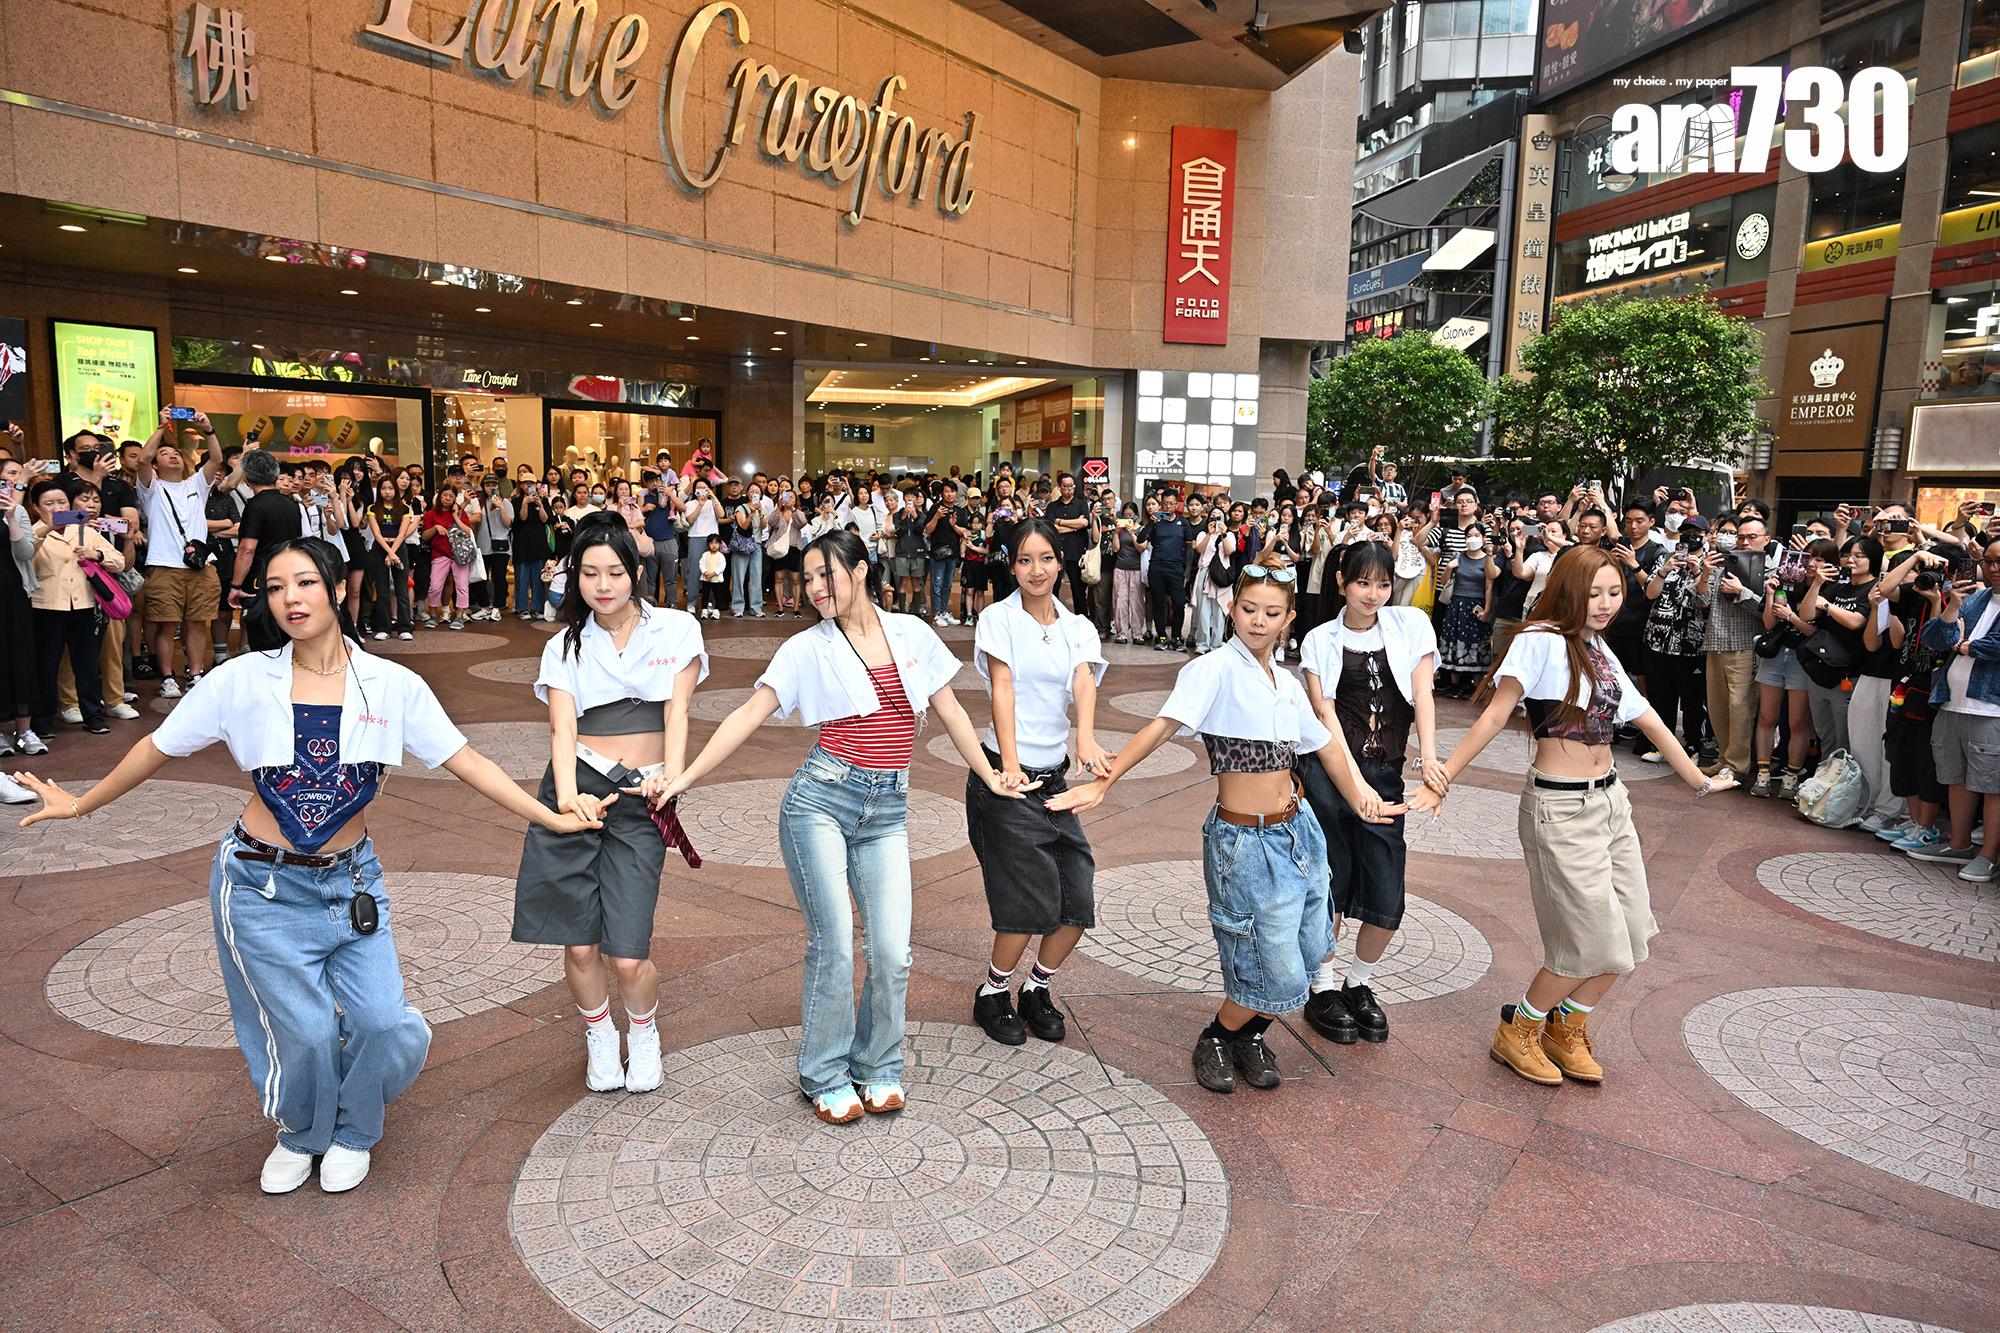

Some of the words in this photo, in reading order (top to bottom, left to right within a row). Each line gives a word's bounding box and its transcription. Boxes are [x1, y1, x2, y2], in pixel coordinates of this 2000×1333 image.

[184, 2, 259, 110] 佛
[664, 1, 983, 225] Crawford
[1177, 156, 1227, 286] 食通天
[1353, 279, 1381, 295] EuroEyes
[1176, 297, 1219, 308] FOOD
[1175, 307, 1219, 319] FORUM
[462, 369, 482, 384] Lane
[482, 370, 519, 389] Crawford
[1790, 404, 1855, 420] EMPEROR
[294, 419, 312, 442] SALE
[337, 422, 354, 445] SALE
[298, 792, 333, 802] COWBOY
